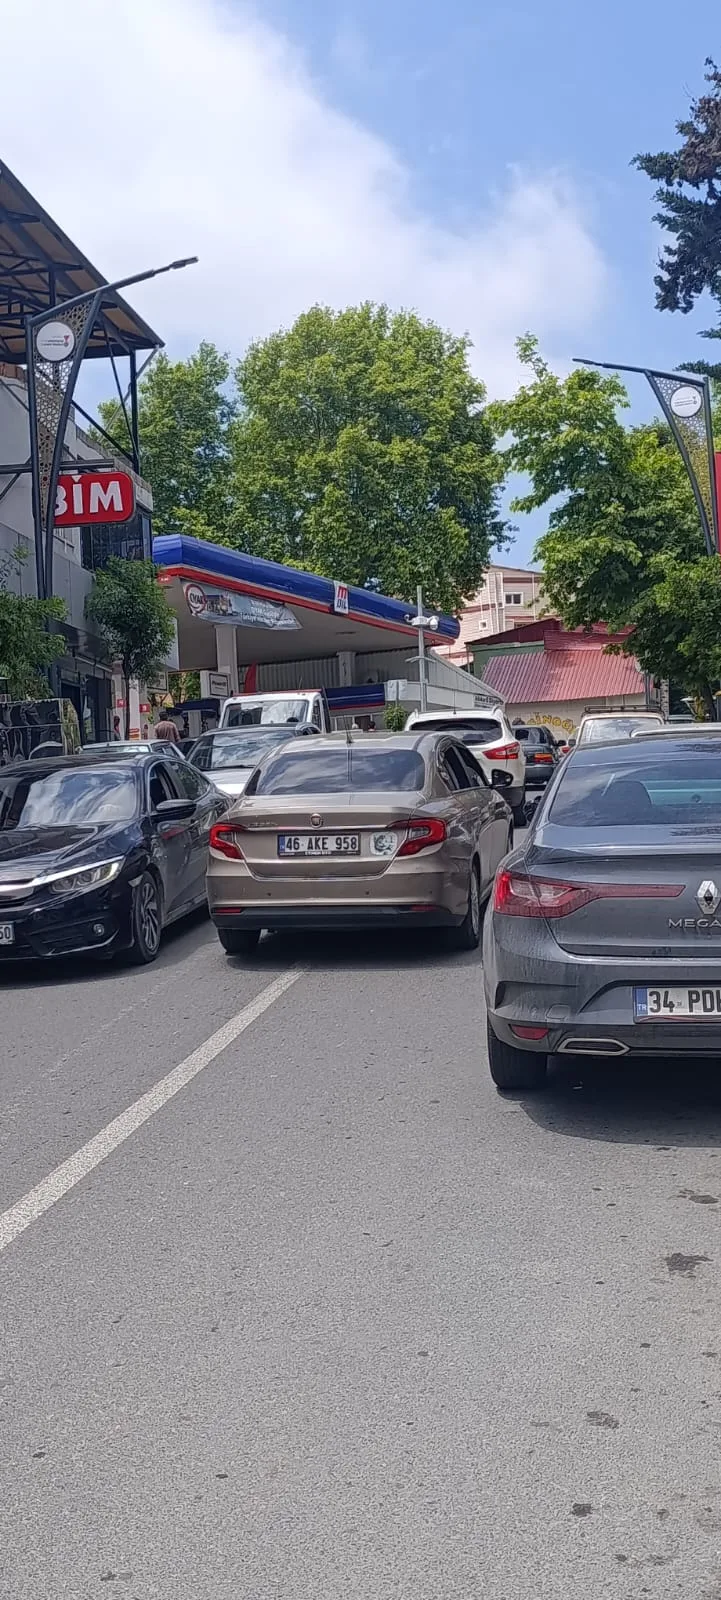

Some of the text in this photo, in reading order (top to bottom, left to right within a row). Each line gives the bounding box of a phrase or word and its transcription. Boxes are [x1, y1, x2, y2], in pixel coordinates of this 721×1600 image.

[286, 836, 357, 850] 46 AKE 958
[649, 990, 675, 1013] 34
